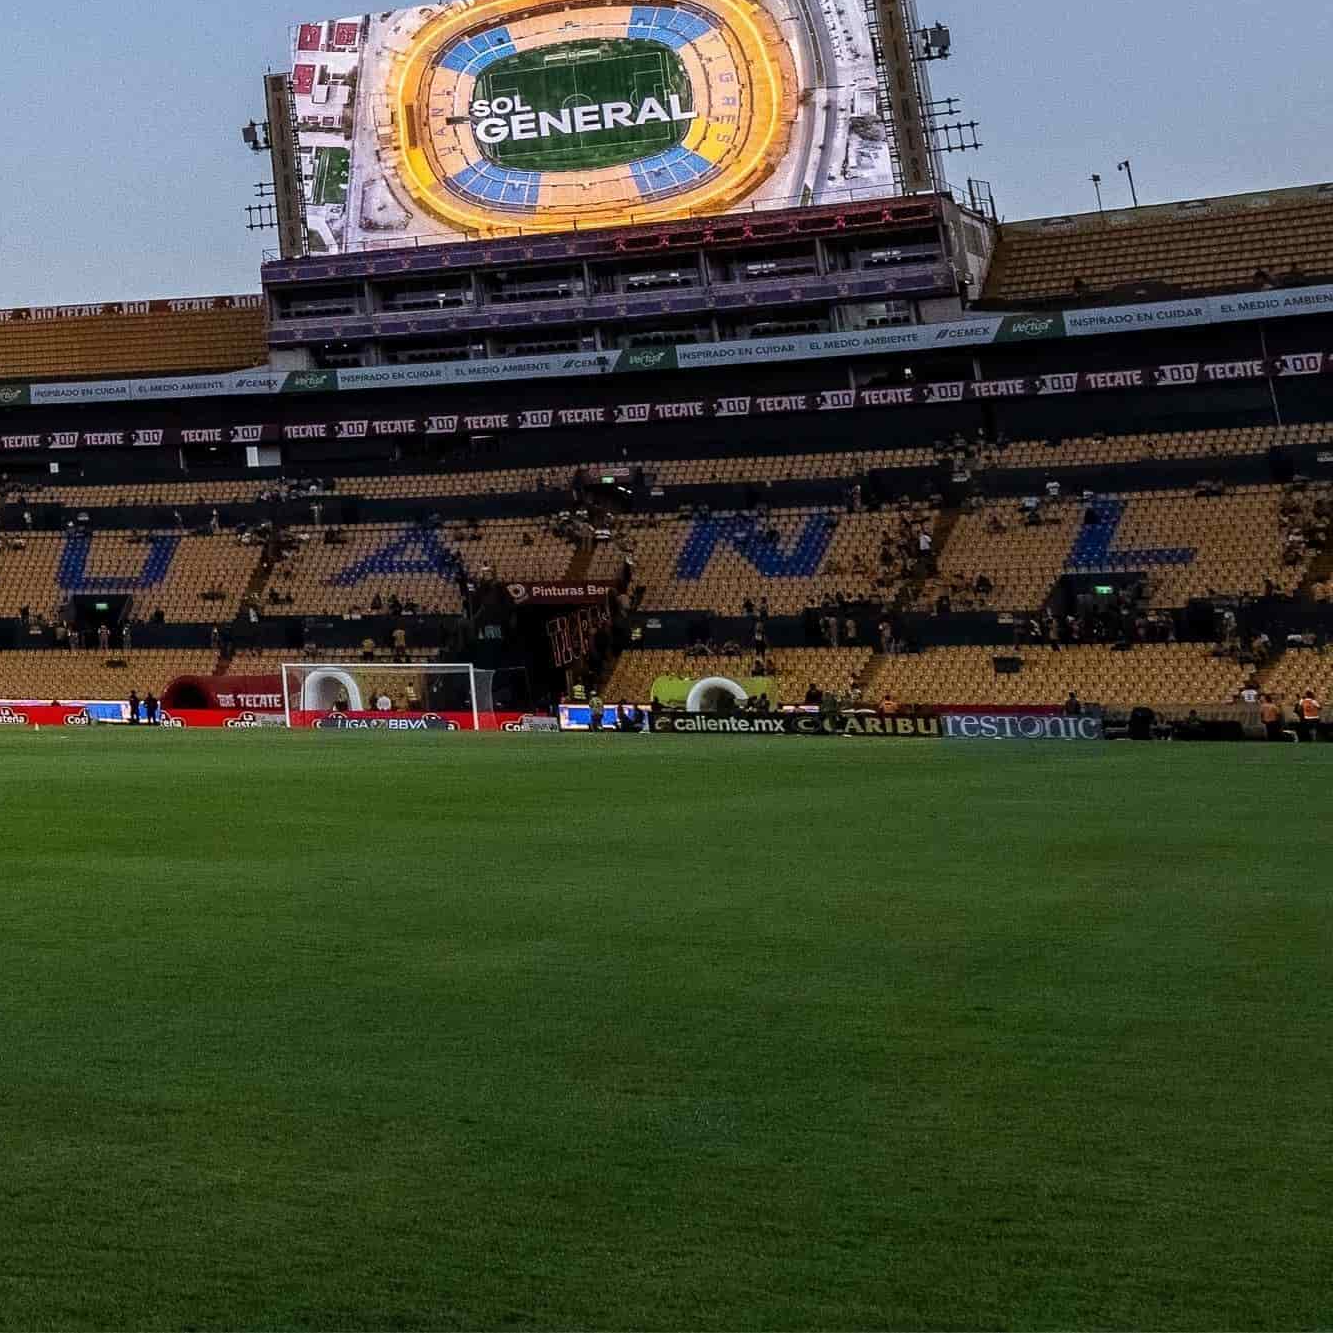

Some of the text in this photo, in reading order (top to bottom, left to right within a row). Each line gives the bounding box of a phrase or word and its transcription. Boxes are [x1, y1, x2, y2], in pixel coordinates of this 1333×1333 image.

[469, 95, 532, 119] SOL
[475, 92, 698, 144] GENERAL
[1070, 314, 1133, 327] INSPIRADO
[1137, 312, 1153, 322] EN
[1157, 307, 1203, 320] CUIDAR
[1221, 304, 1236, 313] EL
[1238, 299, 1279, 311] MEDIO
[949, 327, 990, 338] CEMEX
[680, 333, 918, 360] INSPIRADO EN CUIDAR EL MEDIO AMBIENTE
[1203, 360, 1264, 380] TECATE
[1085, 370, 1141, 389] TECATE
[862, 388, 914, 404] TECATE
[972, 380, 1025, 397] TECATE
[655, 402, 703, 418] TECATE
[757, 396, 806, 412] TECATE
[464, 415, 509, 429] TECATE
[558, 408, 605, 424] TECATE
[285, 424, 326, 439] TECATE
[373, 420, 416, 435] TECATE
[1, 435, 41, 449] TECATE
[84, 433, 124, 445] TECATE
[181, 429, 221, 443] TECATE
[532, 585, 584, 597] Pinturas
[237, 694, 282, 707] TECATE
[388, 719, 428, 730] BBVA
[676, 715, 786, 732] caliente.mx
